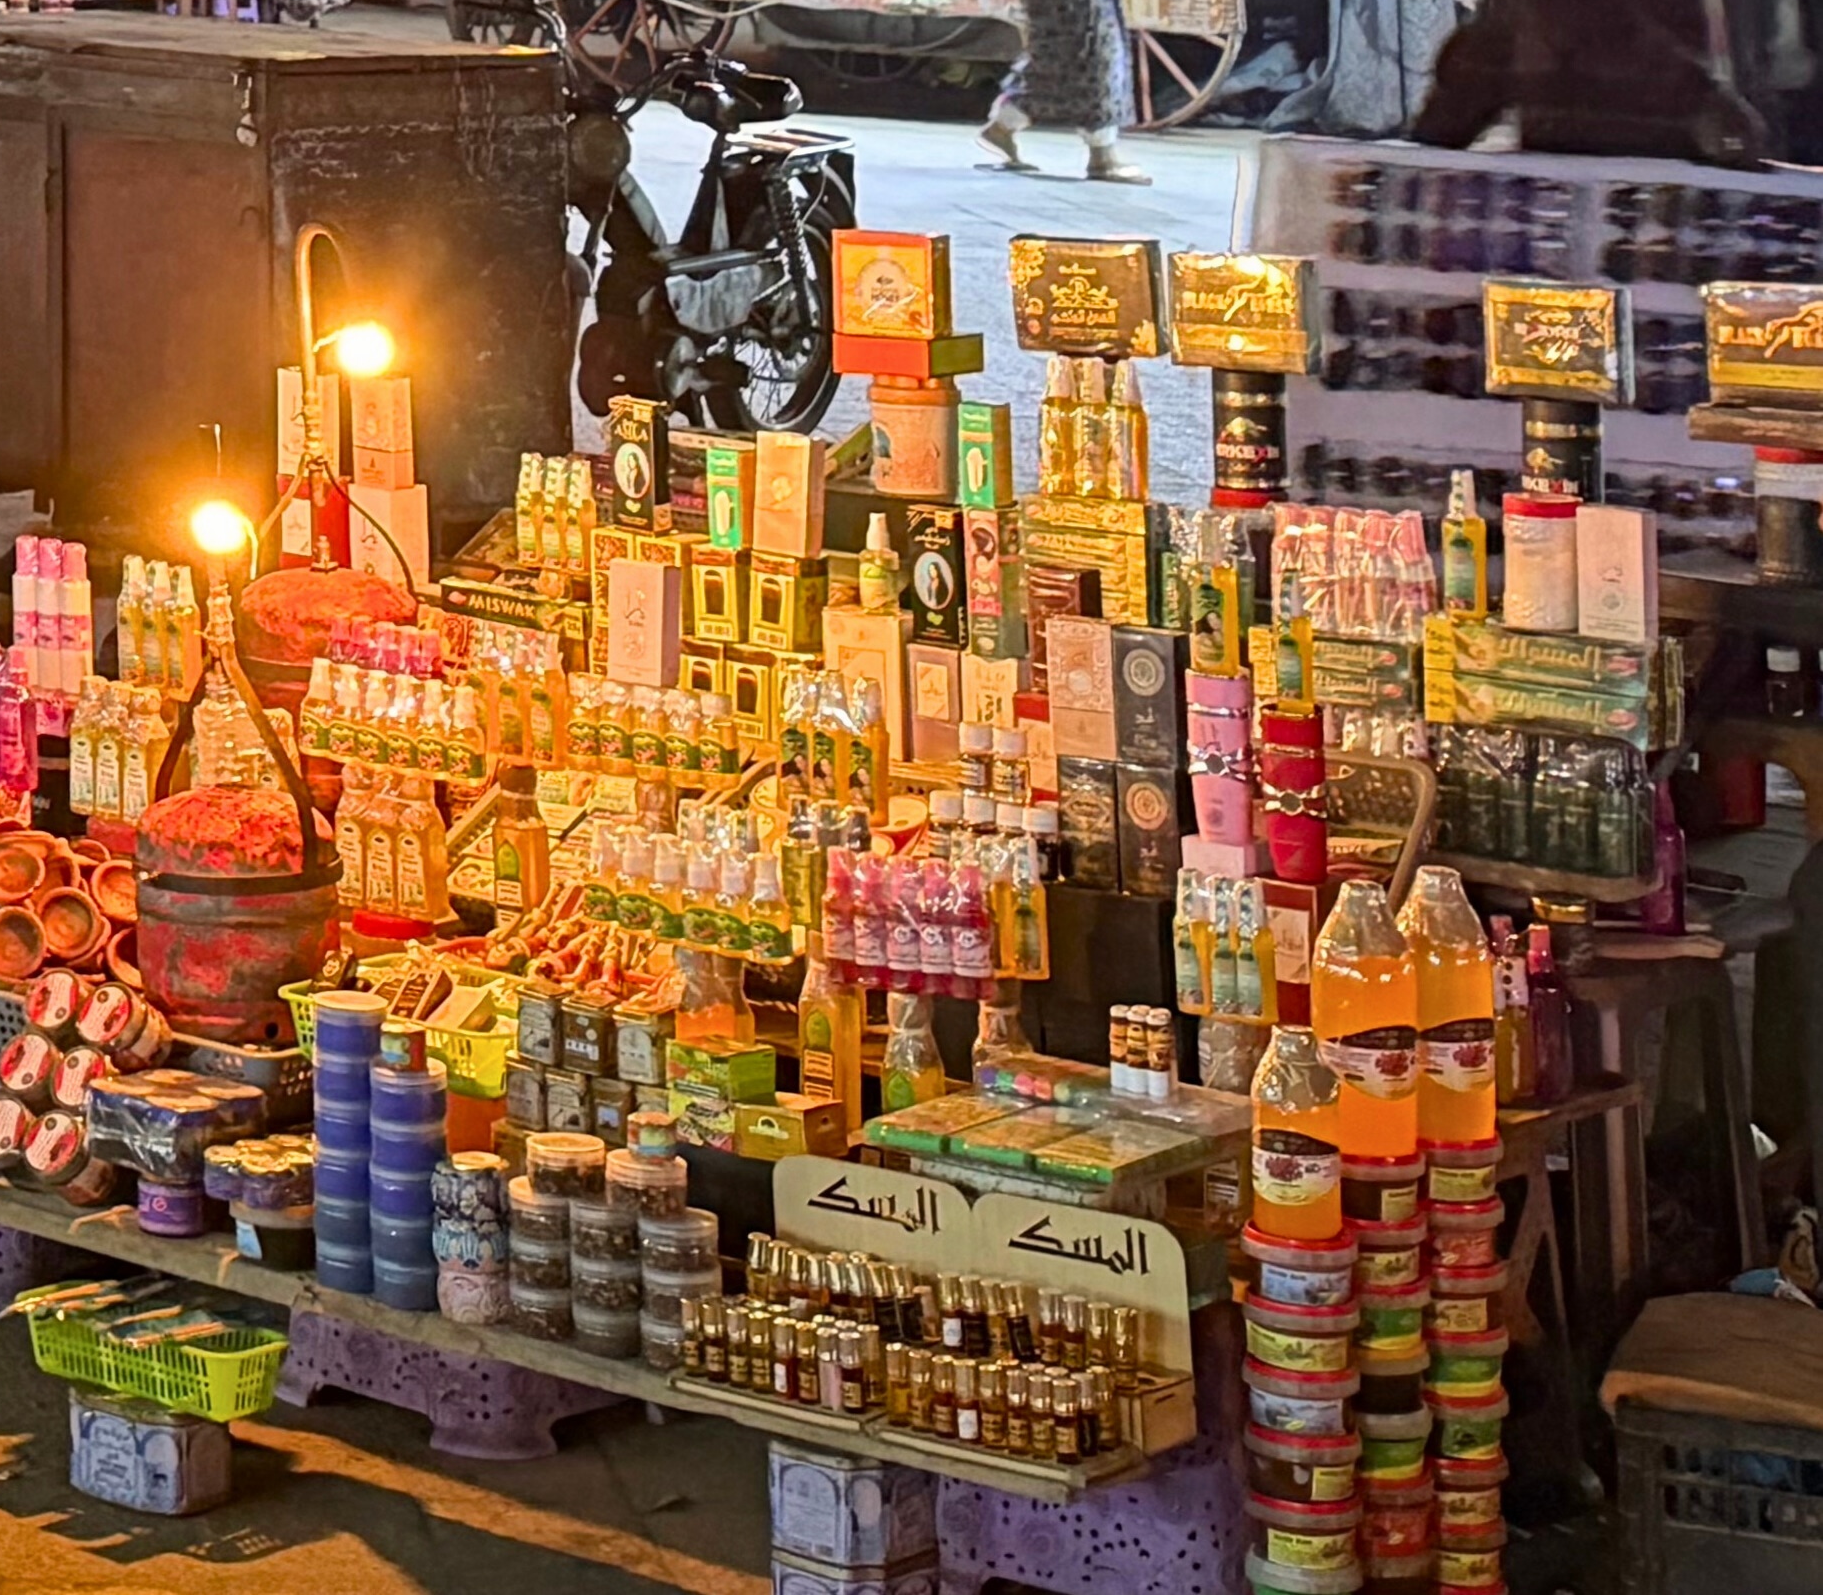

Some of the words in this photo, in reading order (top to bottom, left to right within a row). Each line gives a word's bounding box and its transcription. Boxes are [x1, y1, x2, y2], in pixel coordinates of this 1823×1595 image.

[468, 593, 536, 619] MISWAK
[807, 1176, 942, 1235] المسك
[1008, 1214, 1152, 1277] المسك
